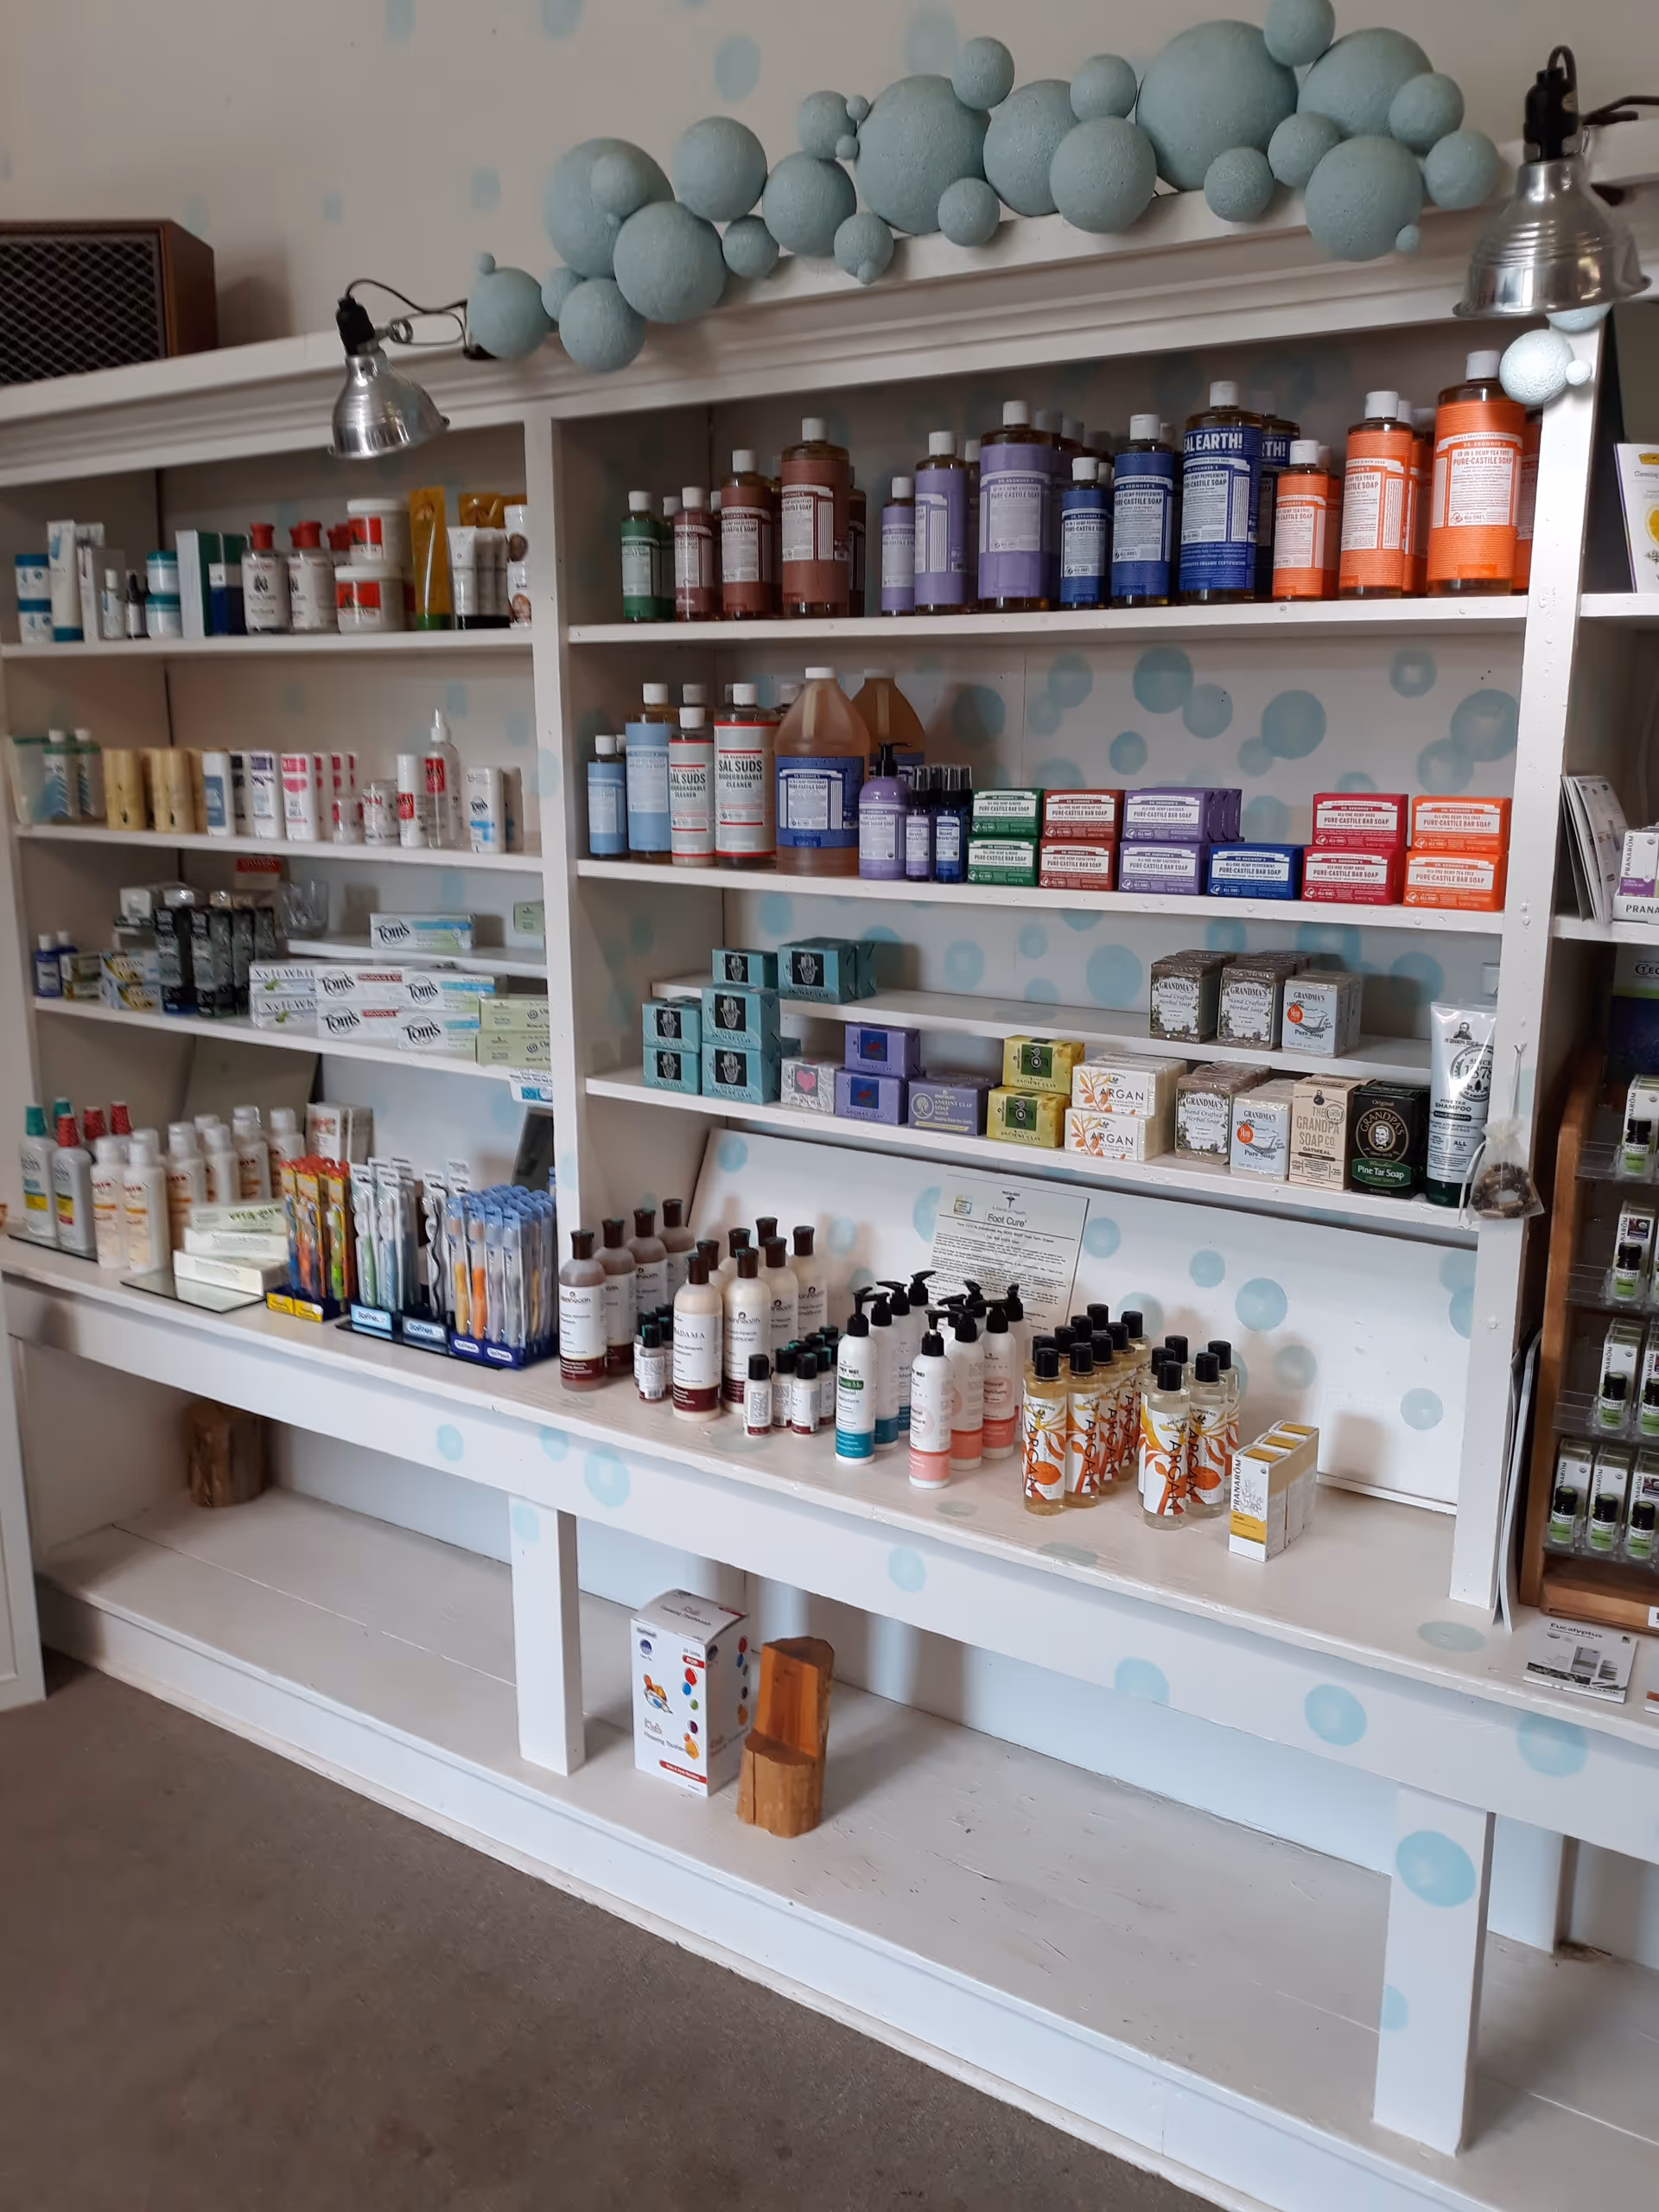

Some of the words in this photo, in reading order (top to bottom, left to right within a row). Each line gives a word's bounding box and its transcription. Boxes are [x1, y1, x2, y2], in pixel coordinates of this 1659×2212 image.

[1197, 433, 1243, 450] EARTH!
[1262, 441, 1286, 457] TH!
[1453, 457, 1497, 466] PURE-CASTILE
[719, 760, 733, 772] SAL
[735, 760, 762, 772] SUDS
[682, 773, 705, 784] SUDS
[1159, 981, 1194, 992] GRANDMA'S
[1230, 986, 1268, 997] GRANDMA'S
[1245, 999, 1266, 1007] Crafted
[1294, 992, 1325, 1001] GRANDMA'S
[401, 1022, 442, 1042] Tom's
[1099, 1088, 1143, 1101] ARGAN
[1186, 1096, 1224, 1108] GRANDMA'S
[1434, 1103, 1471, 1112] SHAMPOO
[1244, 1110, 1276, 1121] GRANDMA'S
[1313, 1106, 1325, 1117] THE
[1297, 1116, 1339, 1135] GRANDPA
[1360, 1111, 1405, 1135] GRANDPA'S
[1090, 1132, 1133, 1146] ARGAN
[1300, 1132, 1323, 1147] SOAP
[1325, 1137, 1336, 1147] CO.
[1261, 1151, 1275, 1160] Soap
[1303, 1147, 1331, 1155] OATMEAL
[1357, 1166, 1373, 1175] Pine
[1386, 1169, 1404, 1180] Soap
[987, 1213, 1005, 1224] Foot
[1007, 1217, 1025, 1227] Cure
[1124, 1395, 1134, 1465] ARGAN
[1106, 1407, 1117, 1478] ARGAN
[1027, 1420, 1039, 1492] ARGAN
[1084, 1419, 1097, 1487] ARGAN
[1186, 1427, 1198, 1496] ARGAN
[1167, 1440, 1182, 1510] ARGAN
[1551, 1623, 1603, 1638] Eucalyptus
